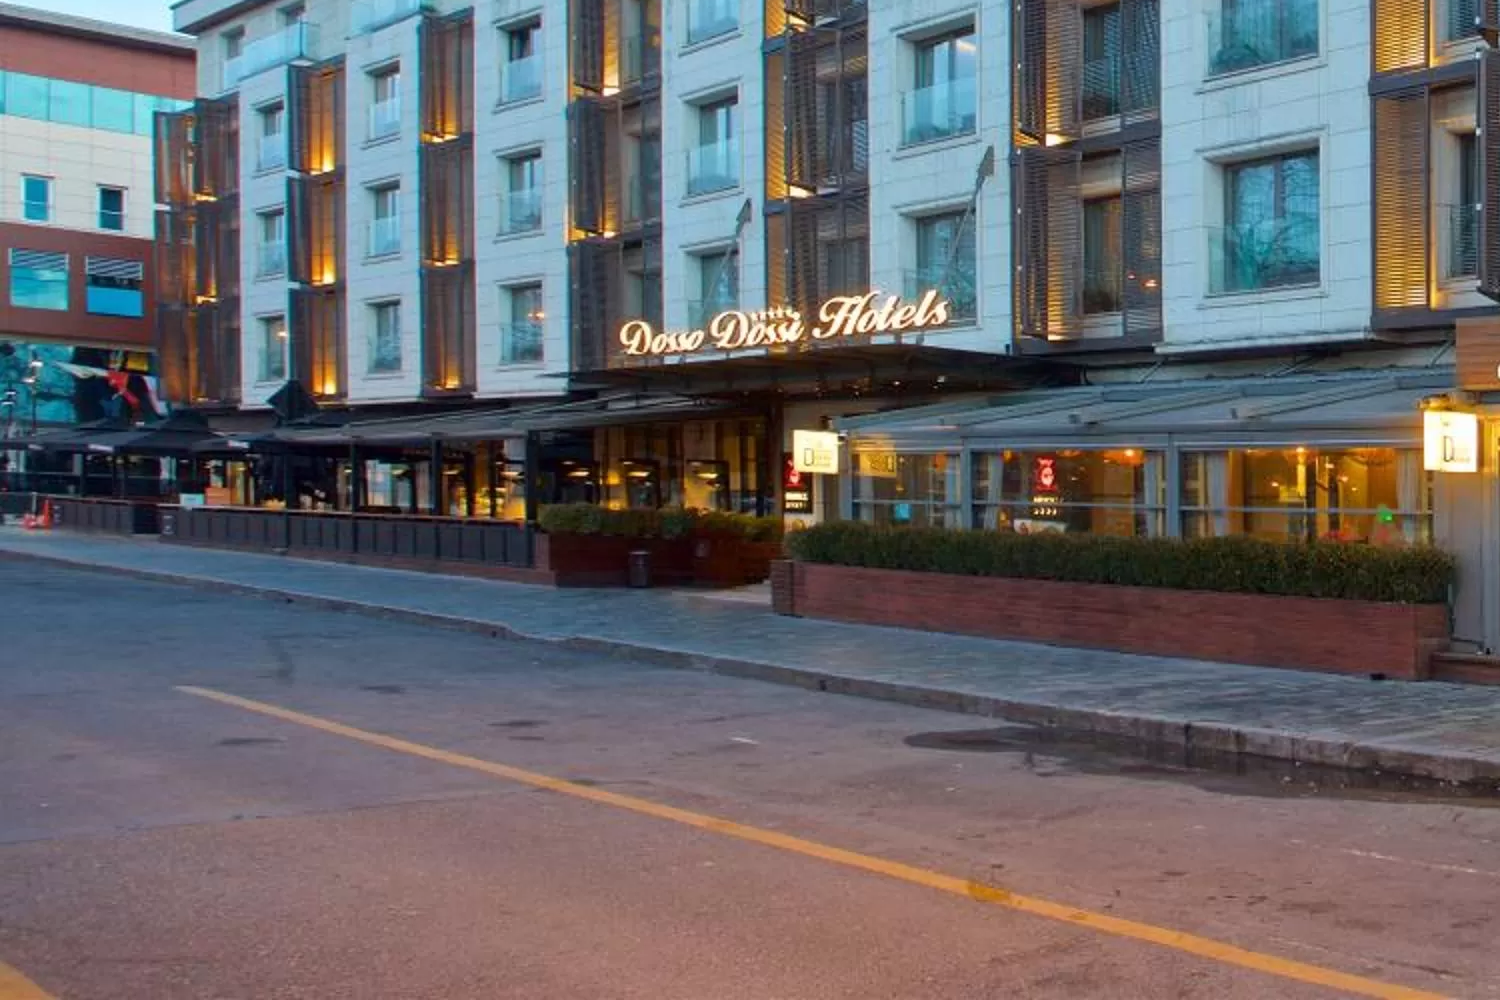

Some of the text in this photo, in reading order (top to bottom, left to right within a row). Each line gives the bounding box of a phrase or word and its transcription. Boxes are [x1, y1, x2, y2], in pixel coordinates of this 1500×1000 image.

[619, 290, 949, 355] Dosso Dossi Hotels
